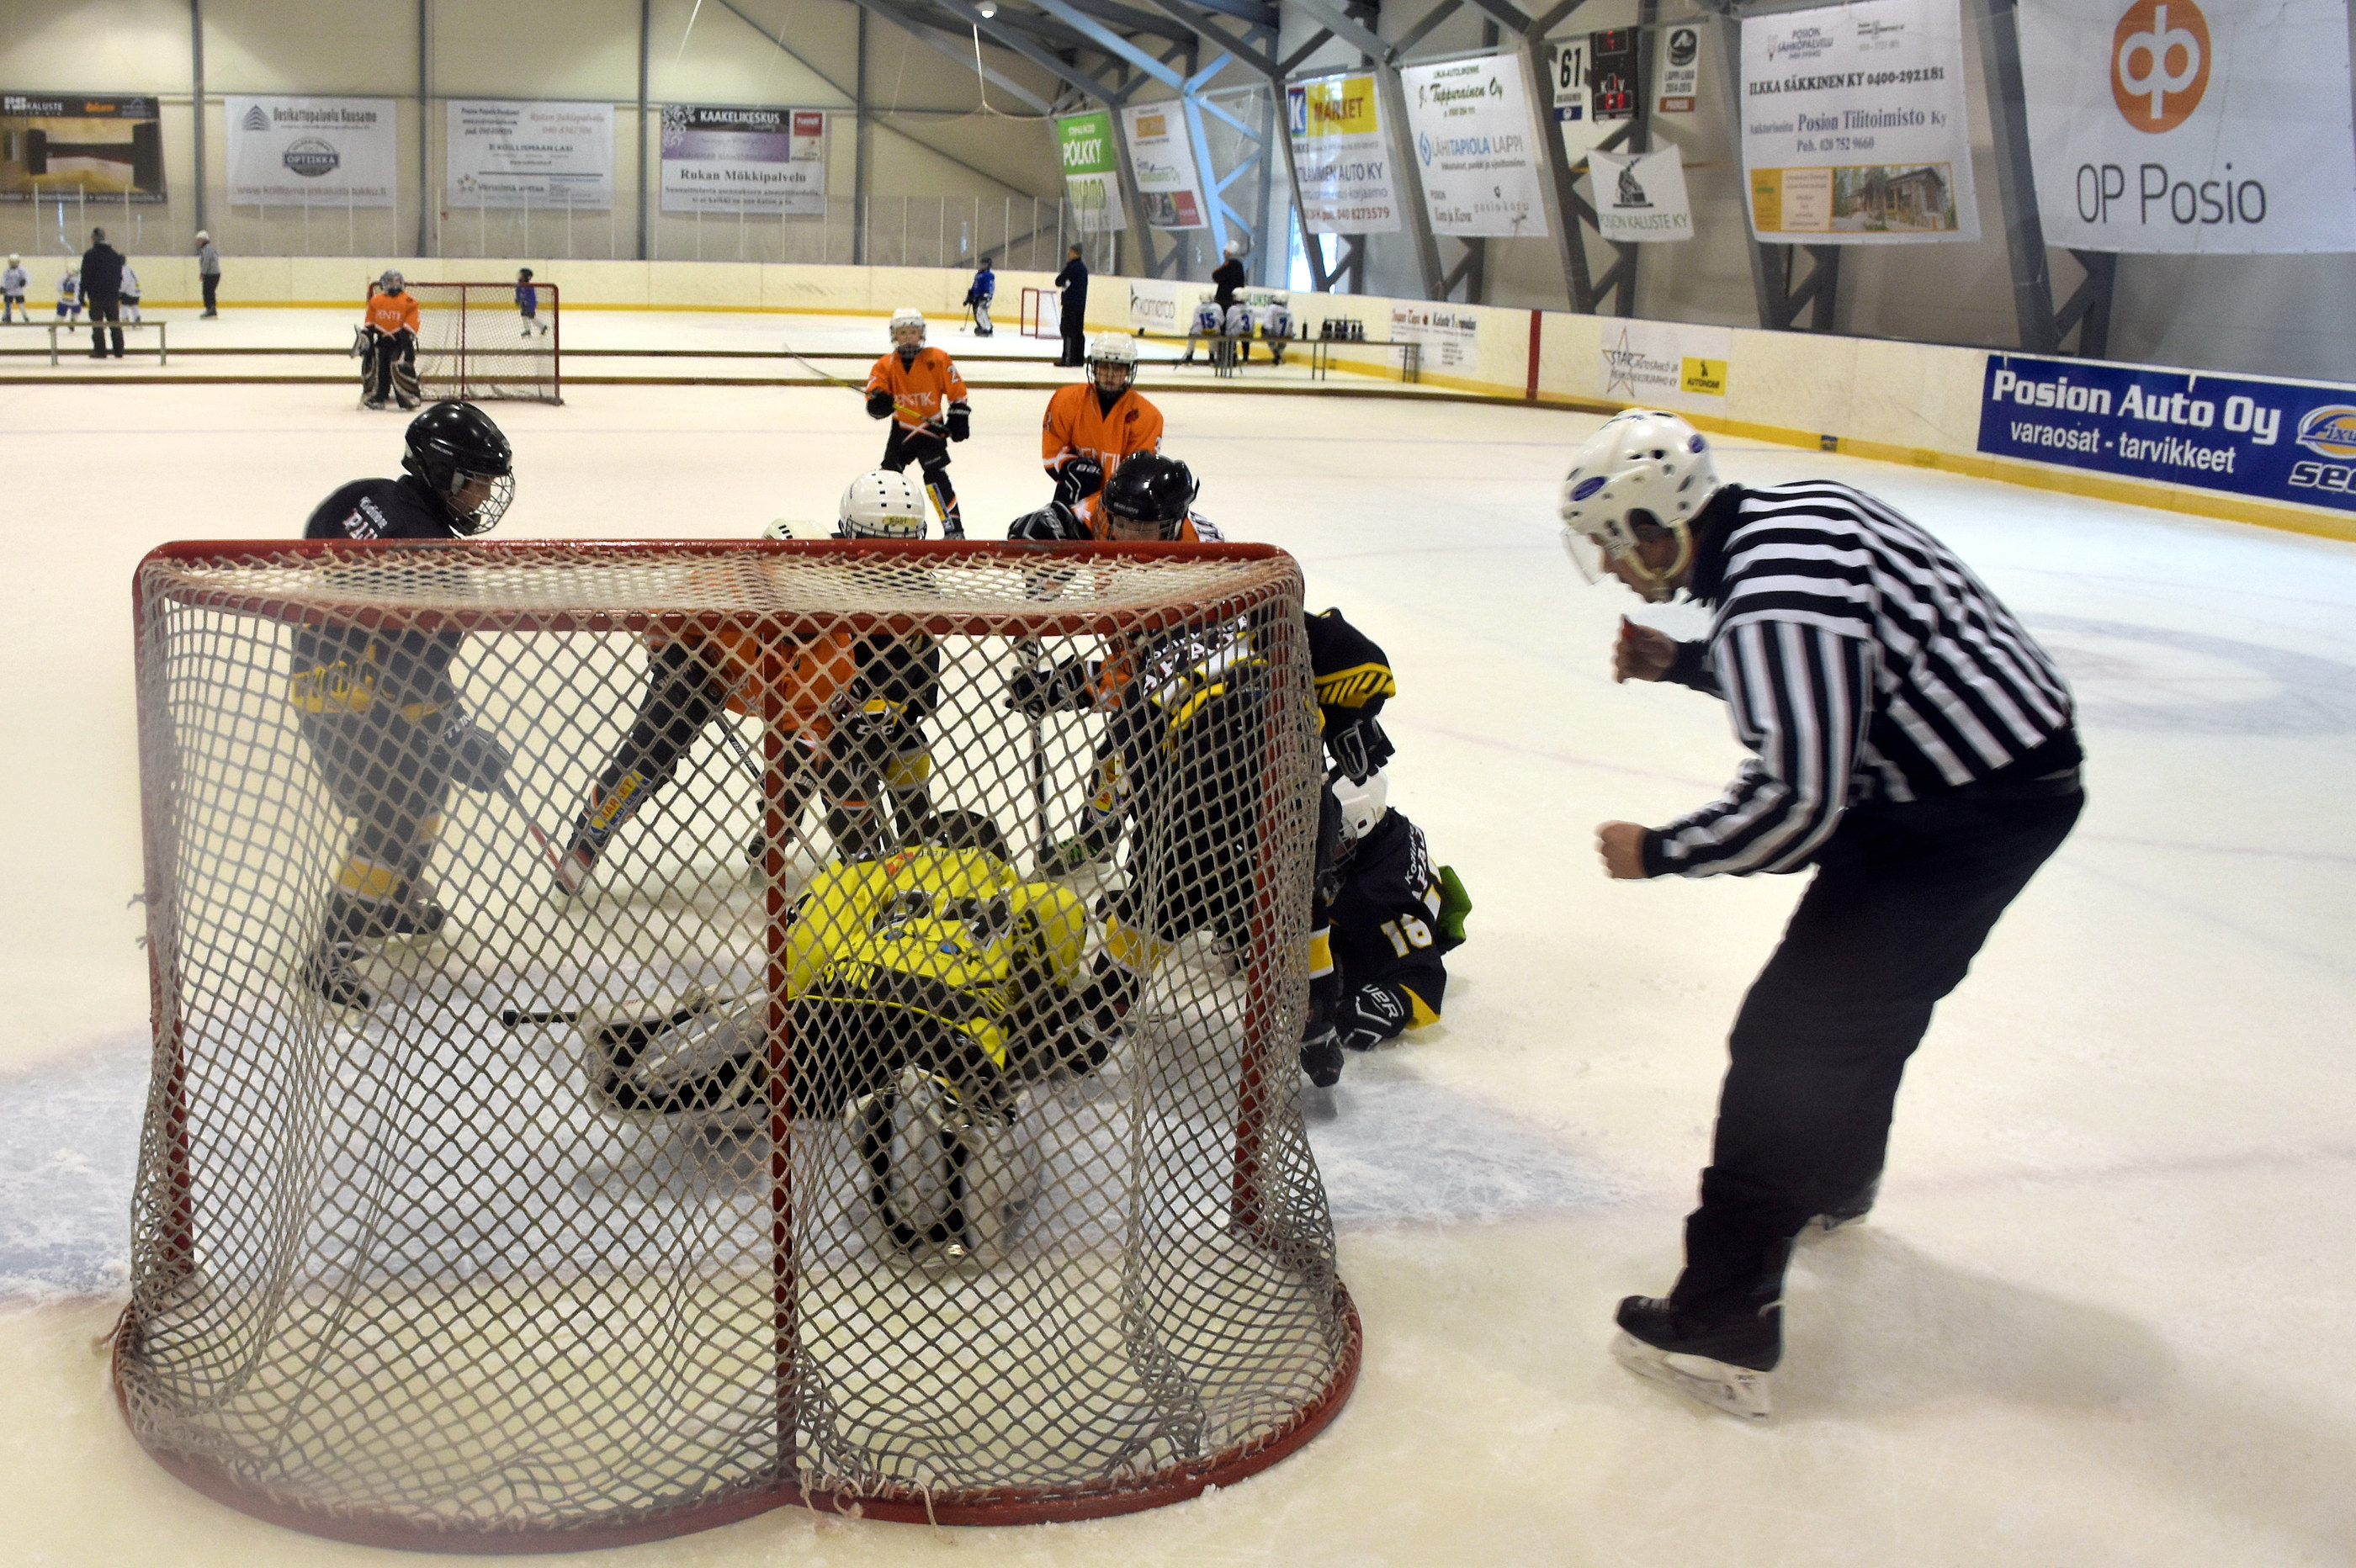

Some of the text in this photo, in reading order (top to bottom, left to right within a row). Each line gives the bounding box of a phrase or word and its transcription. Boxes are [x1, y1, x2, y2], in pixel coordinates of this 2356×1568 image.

[1560, 48, 1581, 87] 61
[1748, 66, 1945, 96] ILKKA SÄKKINEN KY 0400-292181
[699, 110, 780, 124] KAAKELIKESKUS
[1289, 94, 1305, 131] K
[1313, 97, 1365, 123] MARKET
[1797, 112, 1839, 132] Posion
[1842, 107, 1926, 129] Tilitoimisto
[1063, 138, 1102, 167] PÖLKKY
[1492, 134, 1524, 153] LAPPI
[286, 156, 336, 165] OPTIIKKA
[1339, 163, 1365, 182] AUTO
[1366, 162, 1382, 180] KY
[681, 169, 807, 184] Rukan Mökkipalvelu
[2076, 162, 2267, 225] OP Posio
[1672, 212, 1688, 228] KY
[1199, 312, 1216, 330] 15
[1992, 369, 2282, 447] Posion Auto Oy
[2010, 421, 2100, 454] varaosat
[2119, 432, 2237, 474] tarvikkeet
[1380, 914, 1433, 958] 16
